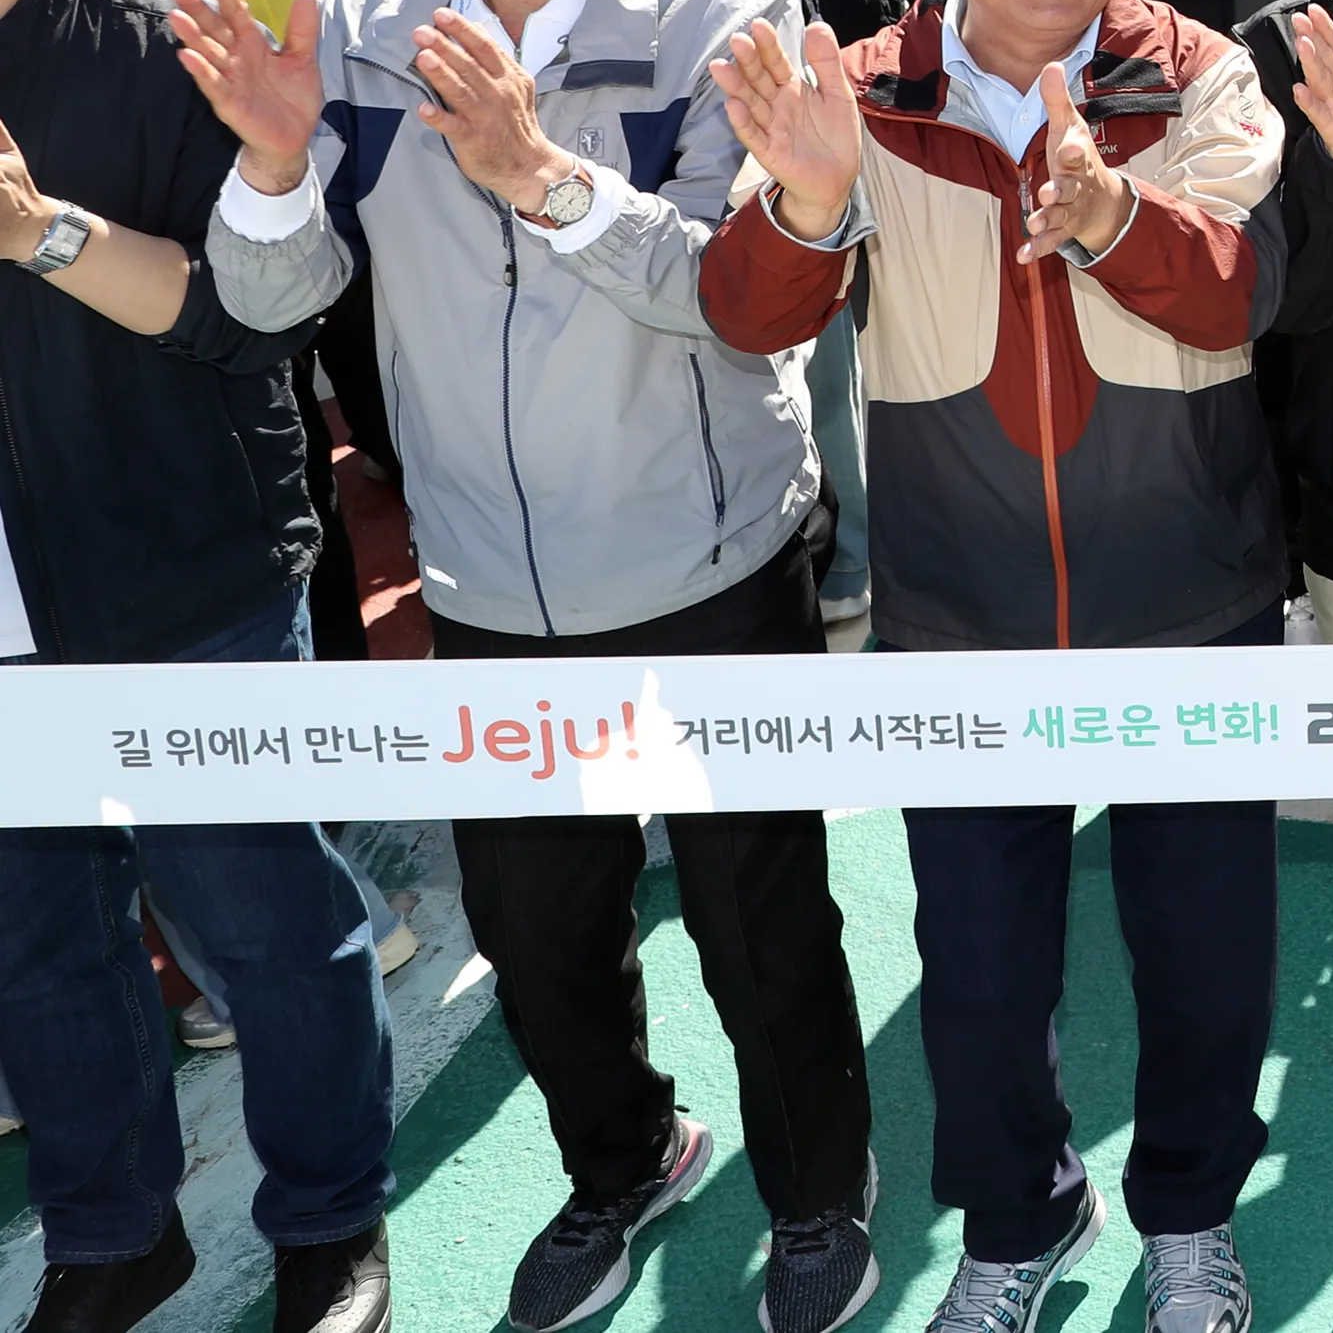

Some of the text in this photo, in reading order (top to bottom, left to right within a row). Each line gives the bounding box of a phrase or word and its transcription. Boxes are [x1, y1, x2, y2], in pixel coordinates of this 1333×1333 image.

[112, 728, 153, 768] 길
[165, 724, 292, 767] 위에서
[303, 723, 430, 765] 만나는
[441, 699, 640, 780] Jeju!
[673, 713, 835, 755] 거리에서
[848, 711, 1008, 753] 시작되는
[1021, 703, 1161, 750] 새로운
[1175, 700, 1280, 748] 변화!
